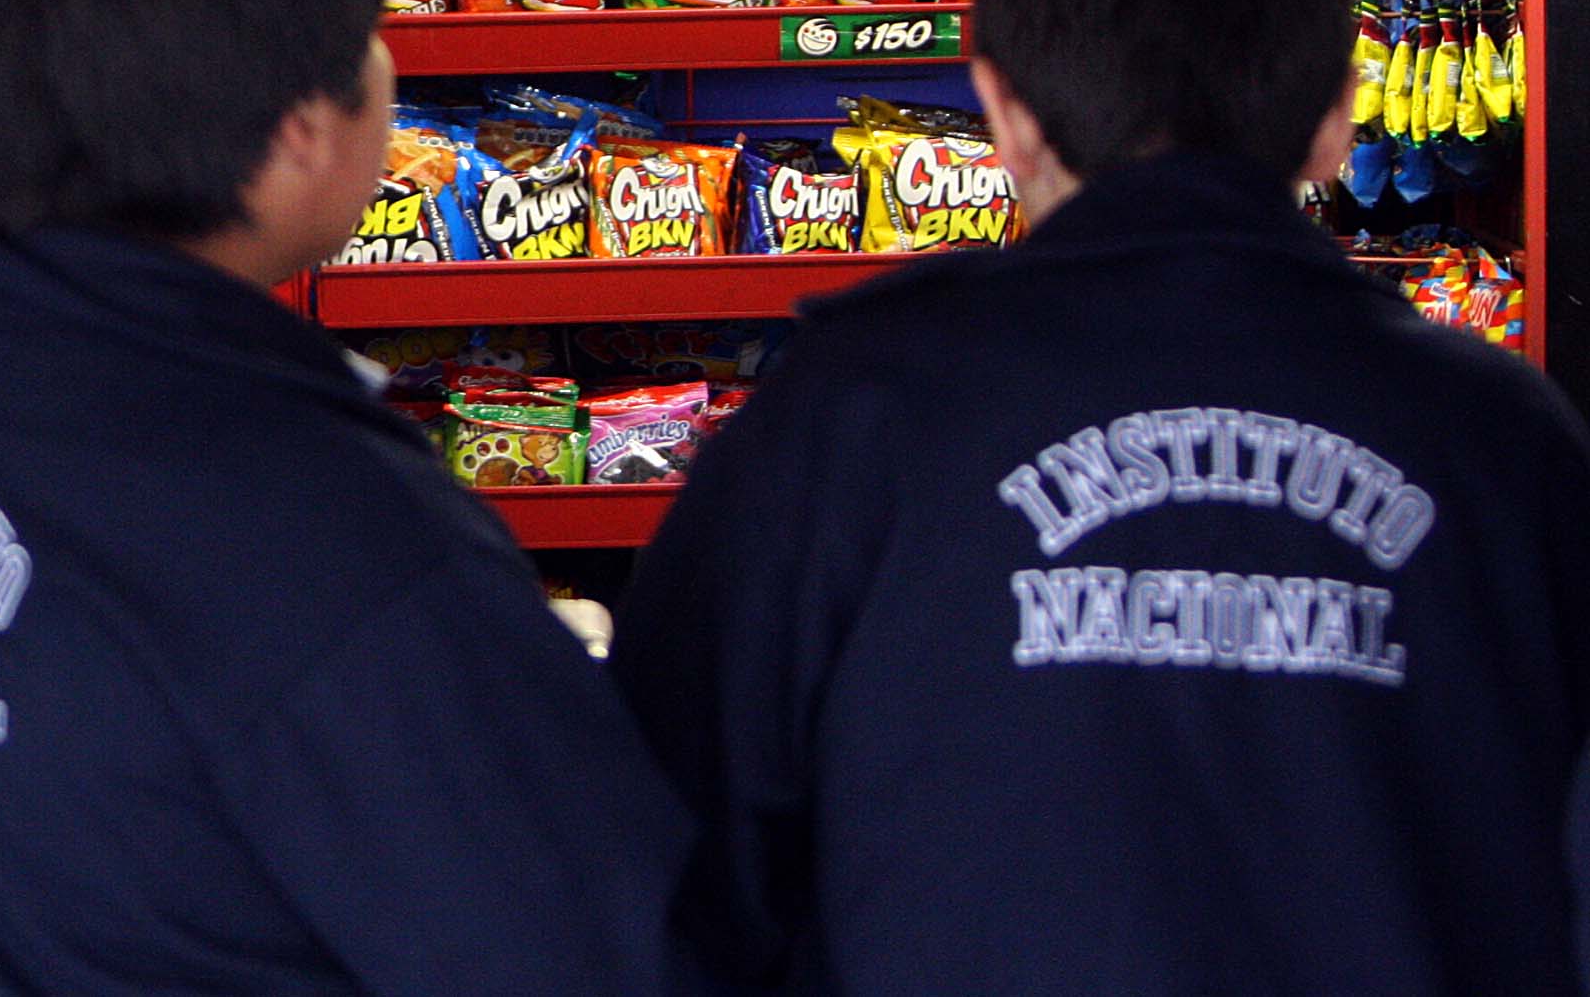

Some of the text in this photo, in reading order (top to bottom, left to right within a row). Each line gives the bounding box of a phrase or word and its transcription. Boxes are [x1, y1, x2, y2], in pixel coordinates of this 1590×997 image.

[853, 19, 933, 52] $150
[512, 221, 587, 260] BKN
[627, 218, 696, 256] BKN
[781, 220, 850, 254] BKN
[913, 208, 1010, 251] BKN
[997, 405, 1438, 571] INSTITUTO
[1011, 565, 1409, 689] NACIONAL
